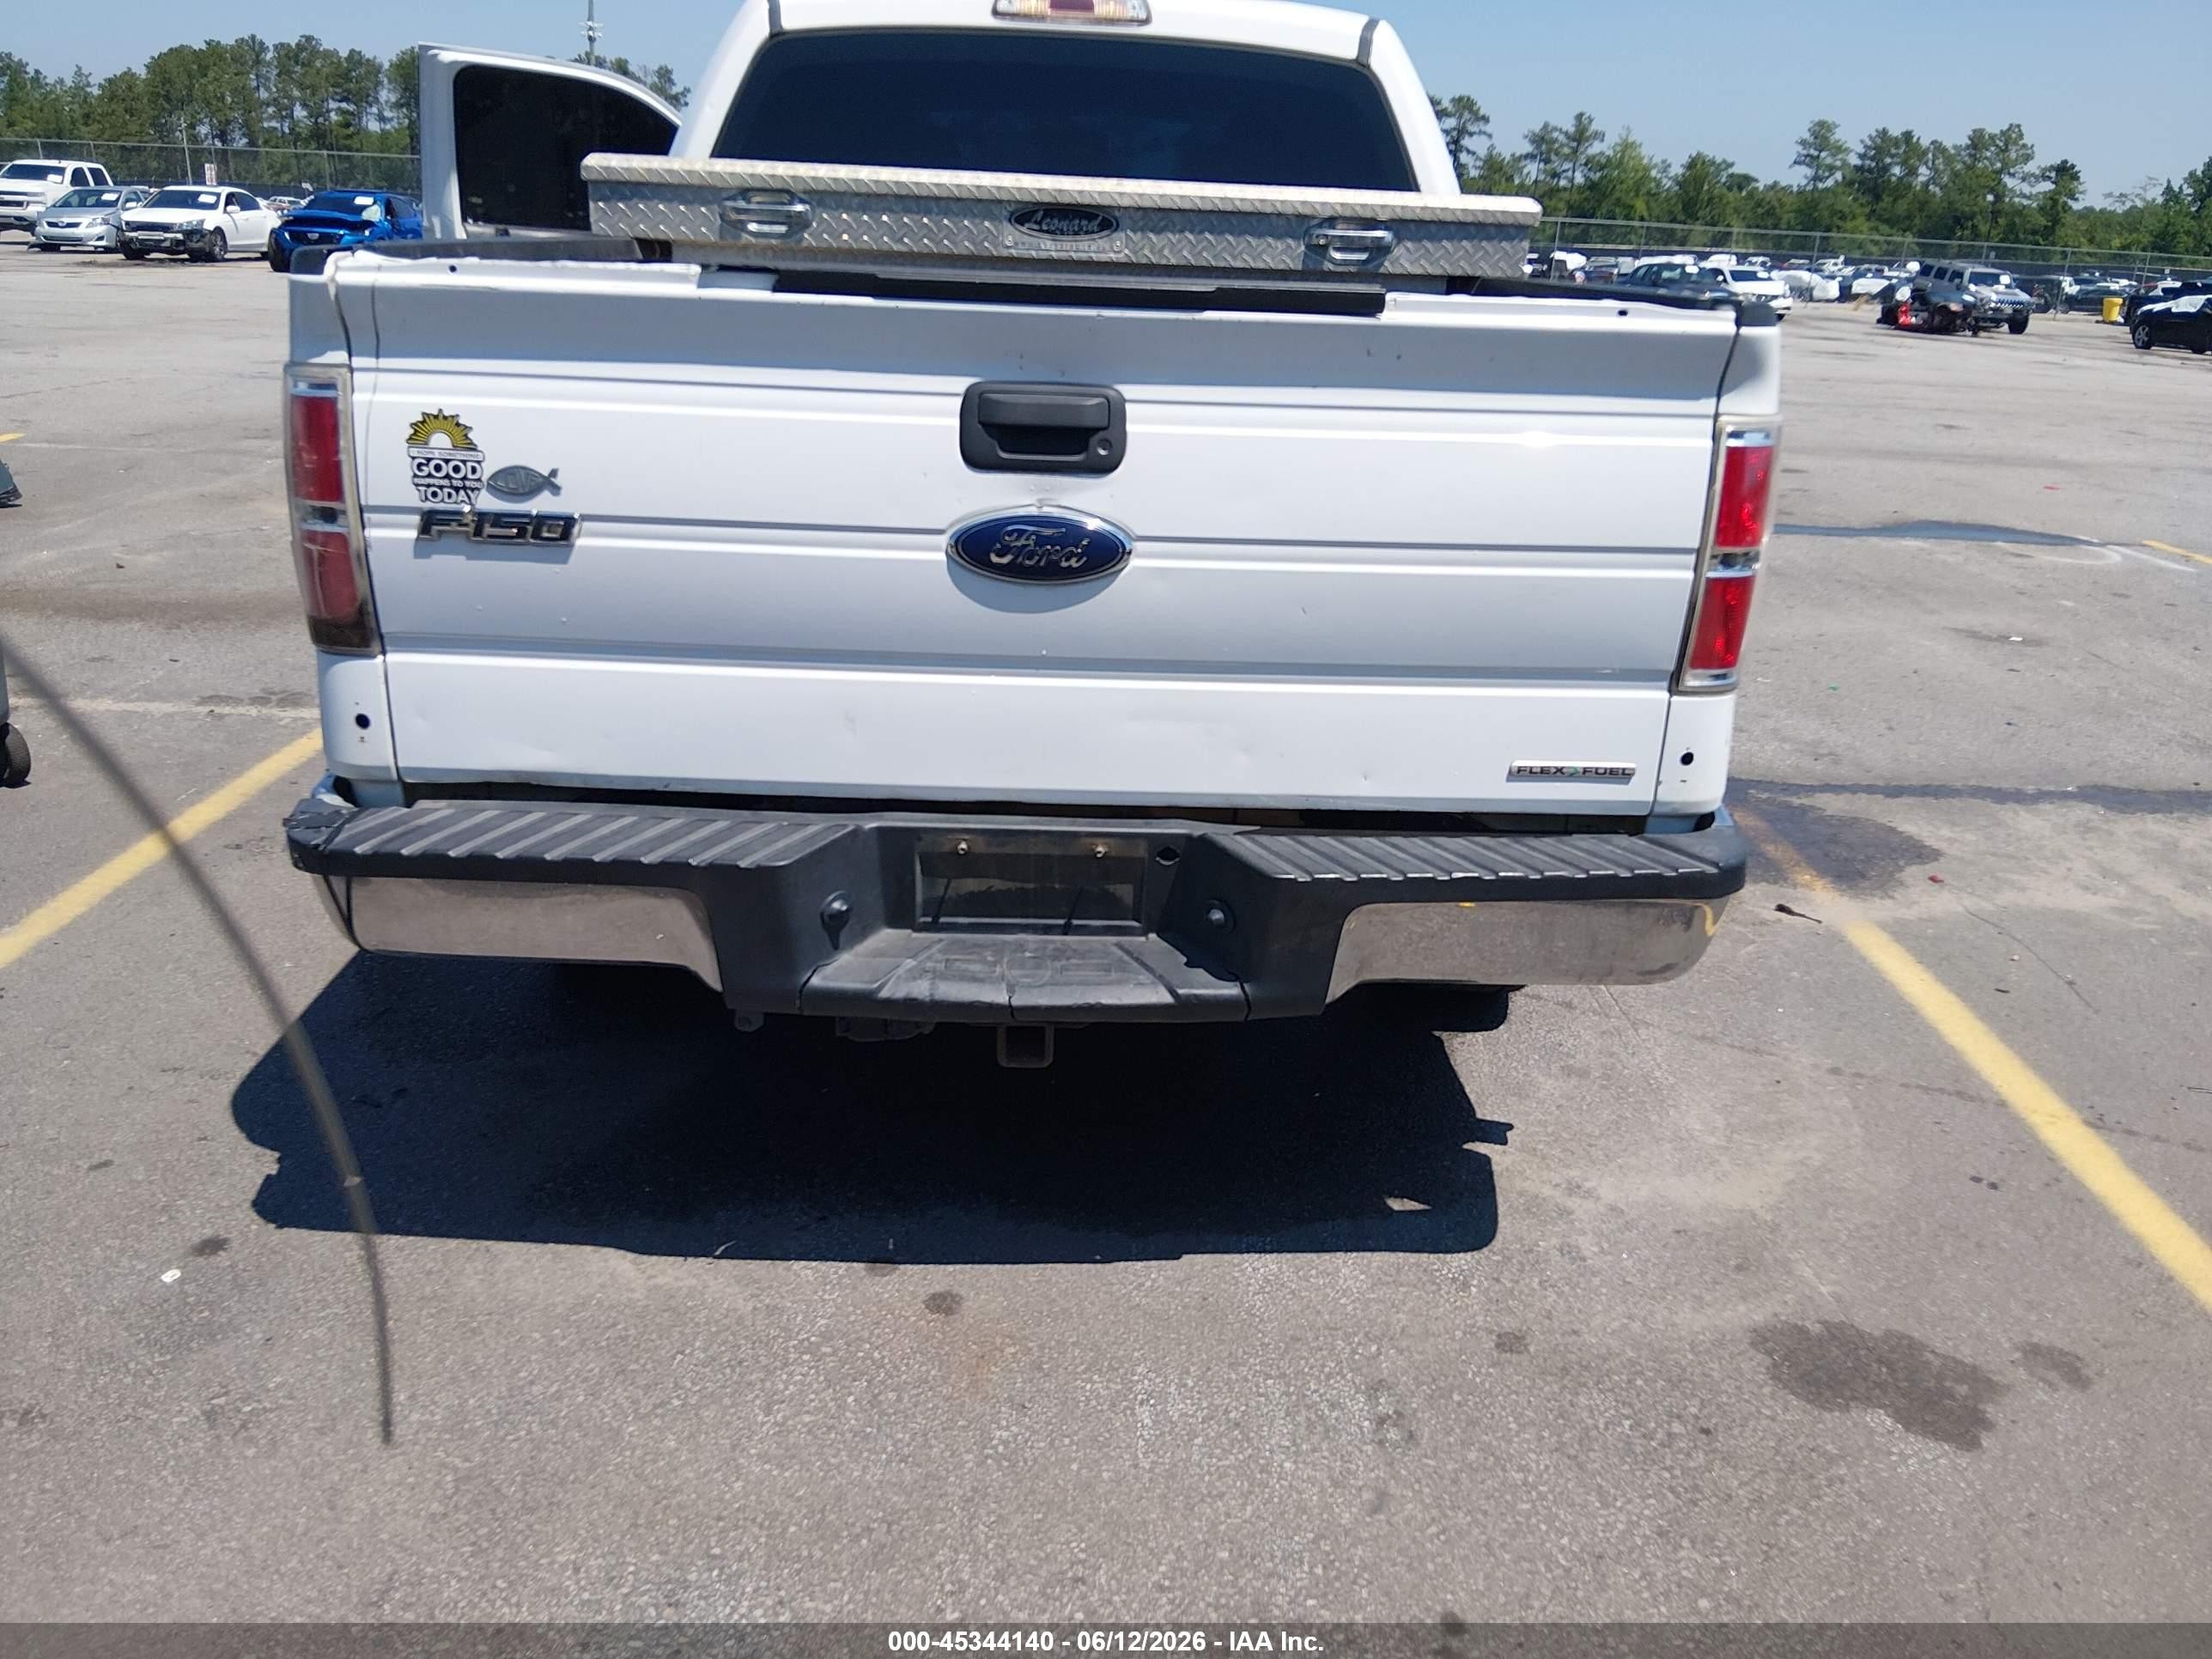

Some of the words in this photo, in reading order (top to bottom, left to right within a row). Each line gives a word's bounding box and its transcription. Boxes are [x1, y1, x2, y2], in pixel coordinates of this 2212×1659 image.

[1024, 208, 1103, 233] Leonard
[412, 458, 483, 480] GOOD
[452, 479, 464, 488] TO
[464, 480, 483, 489] YOU
[417, 487, 480, 505] TODAY
[989, 524, 1091, 568] Ford
[1516, 765, 1566, 775] FLEX
[1581, 767, 1636, 776] FUEL
